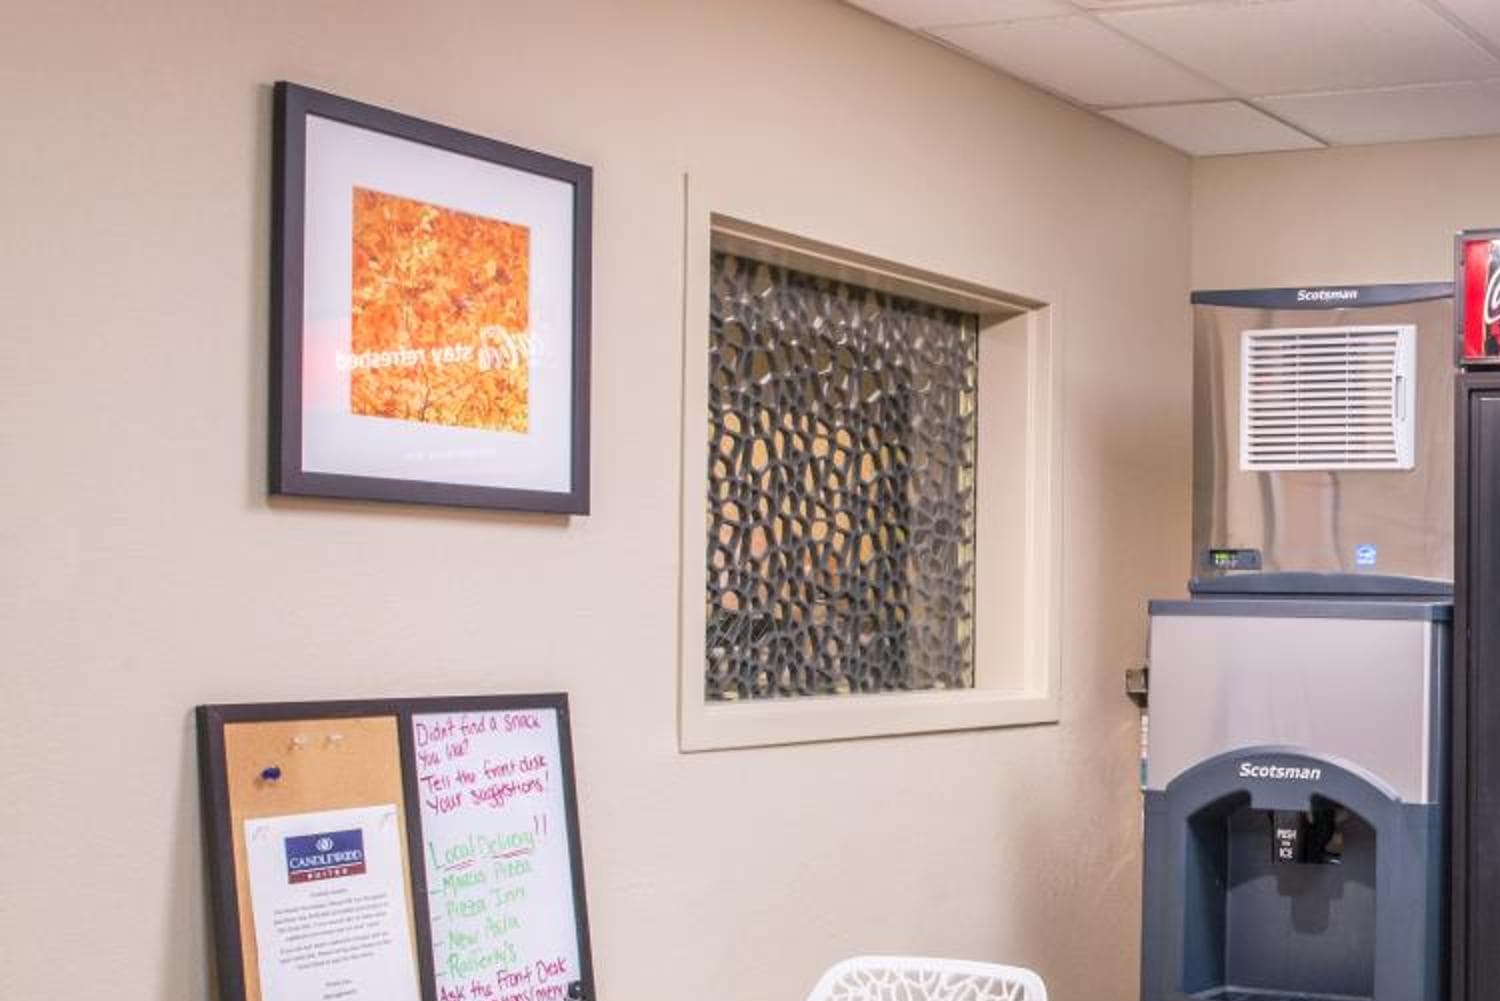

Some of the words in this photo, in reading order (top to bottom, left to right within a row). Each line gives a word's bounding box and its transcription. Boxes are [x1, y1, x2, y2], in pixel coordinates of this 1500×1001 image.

[1296, 289, 1358, 302] Scotsman
[1239, 762, 1322, 780] Scotsman
[420, 774, 450, 793] Tell
